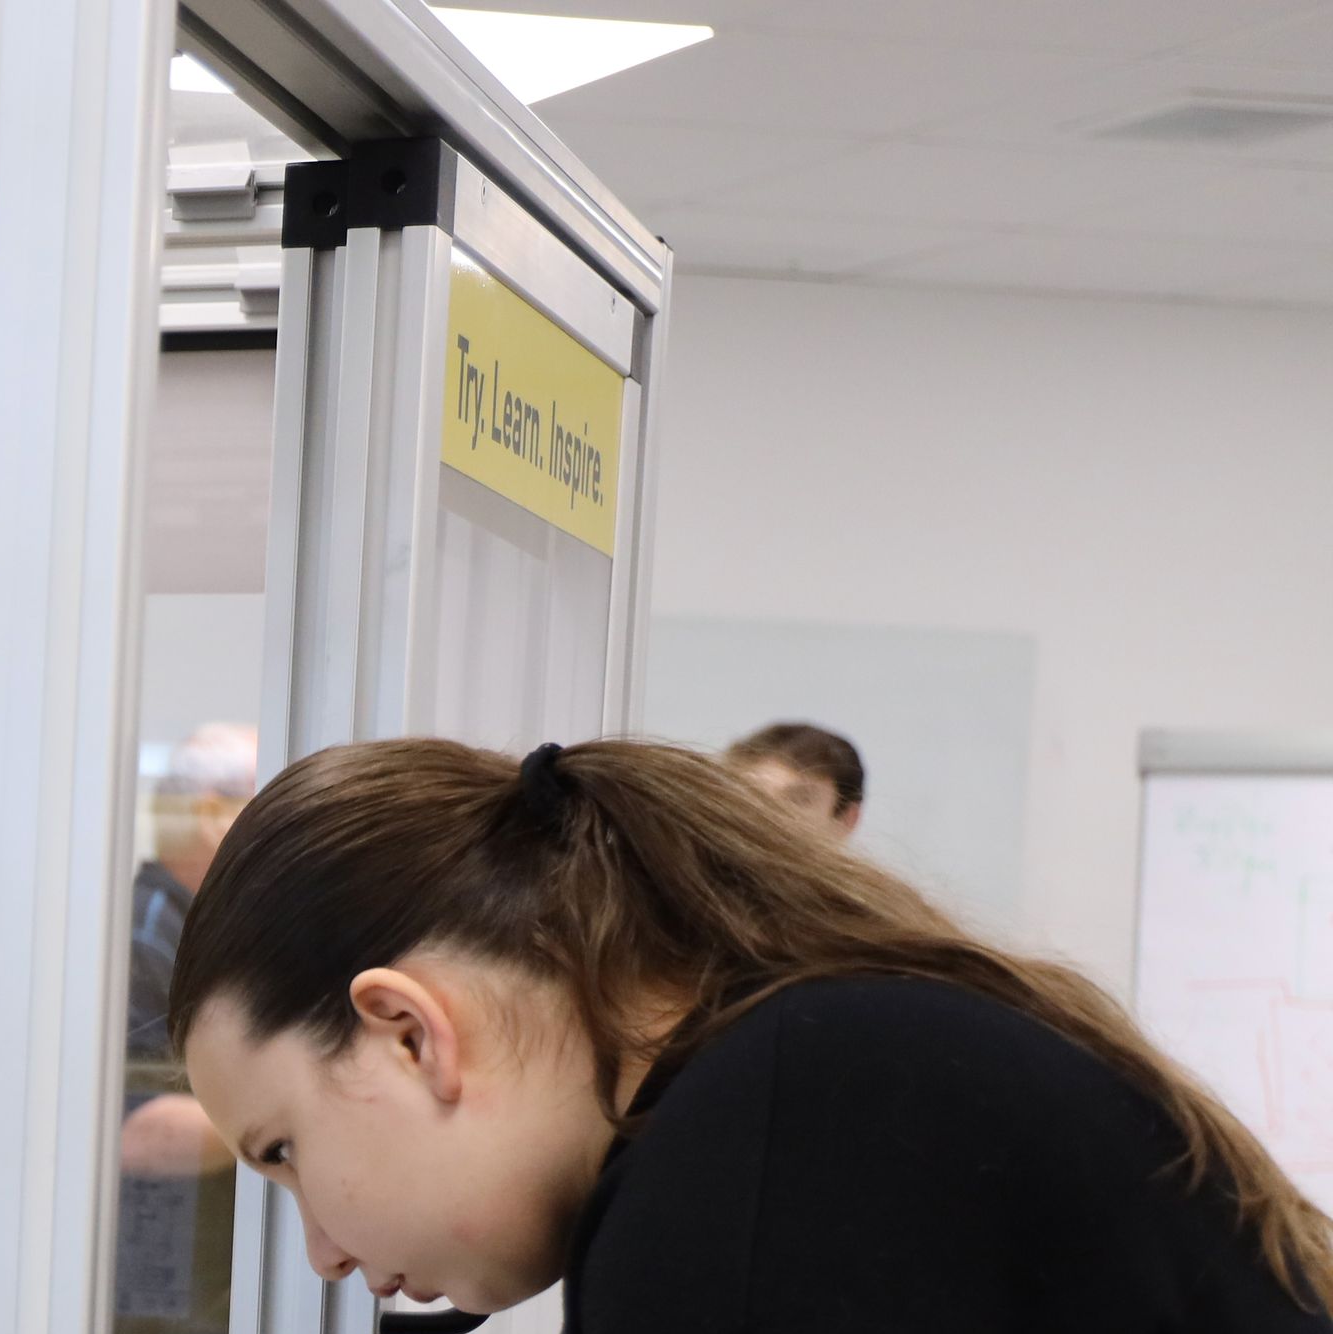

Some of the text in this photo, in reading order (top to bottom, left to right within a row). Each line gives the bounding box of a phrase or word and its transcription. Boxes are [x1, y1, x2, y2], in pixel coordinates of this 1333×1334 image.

[457, 333, 604, 511] Try. Learn. Inspire.
